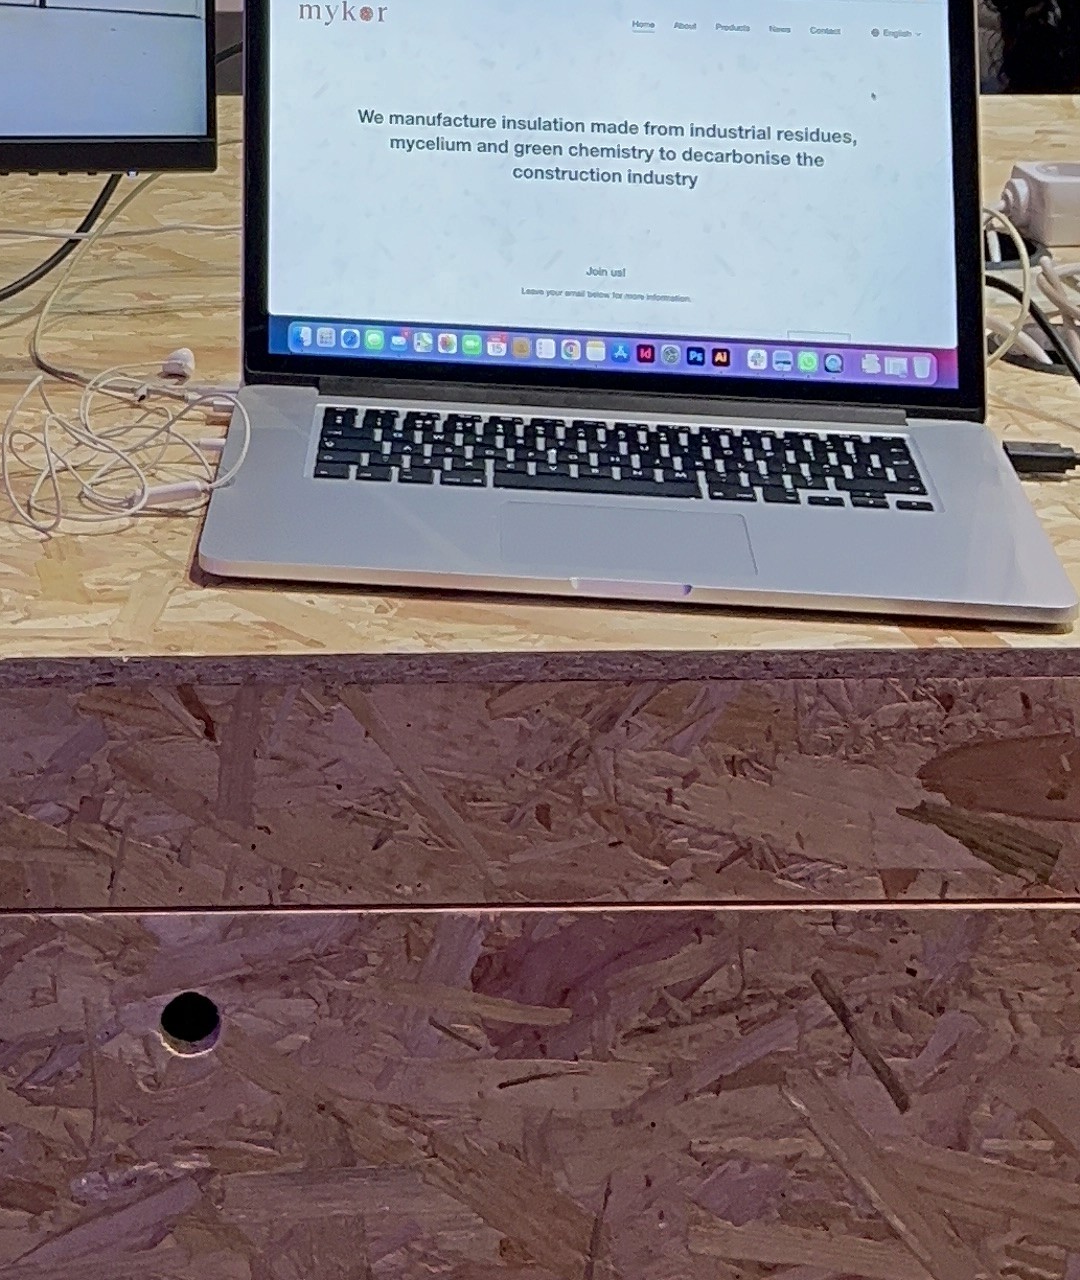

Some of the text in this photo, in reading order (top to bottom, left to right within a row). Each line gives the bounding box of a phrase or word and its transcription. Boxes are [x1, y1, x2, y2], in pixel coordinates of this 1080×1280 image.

[300, 1, 387, 26] mykor
[632, 20, 655, 29] Home
[358, 109, 857, 146] We manufacture insulation made from industrial residues,
[390, 136, 825, 167] mycelium and green chemistry to decarbonise the
[513, 167, 698, 189] construction industry
[586, 267, 626, 277] Join us!
[546, 289, 562, 297] your
[689, 350, 702, 362] Ps
